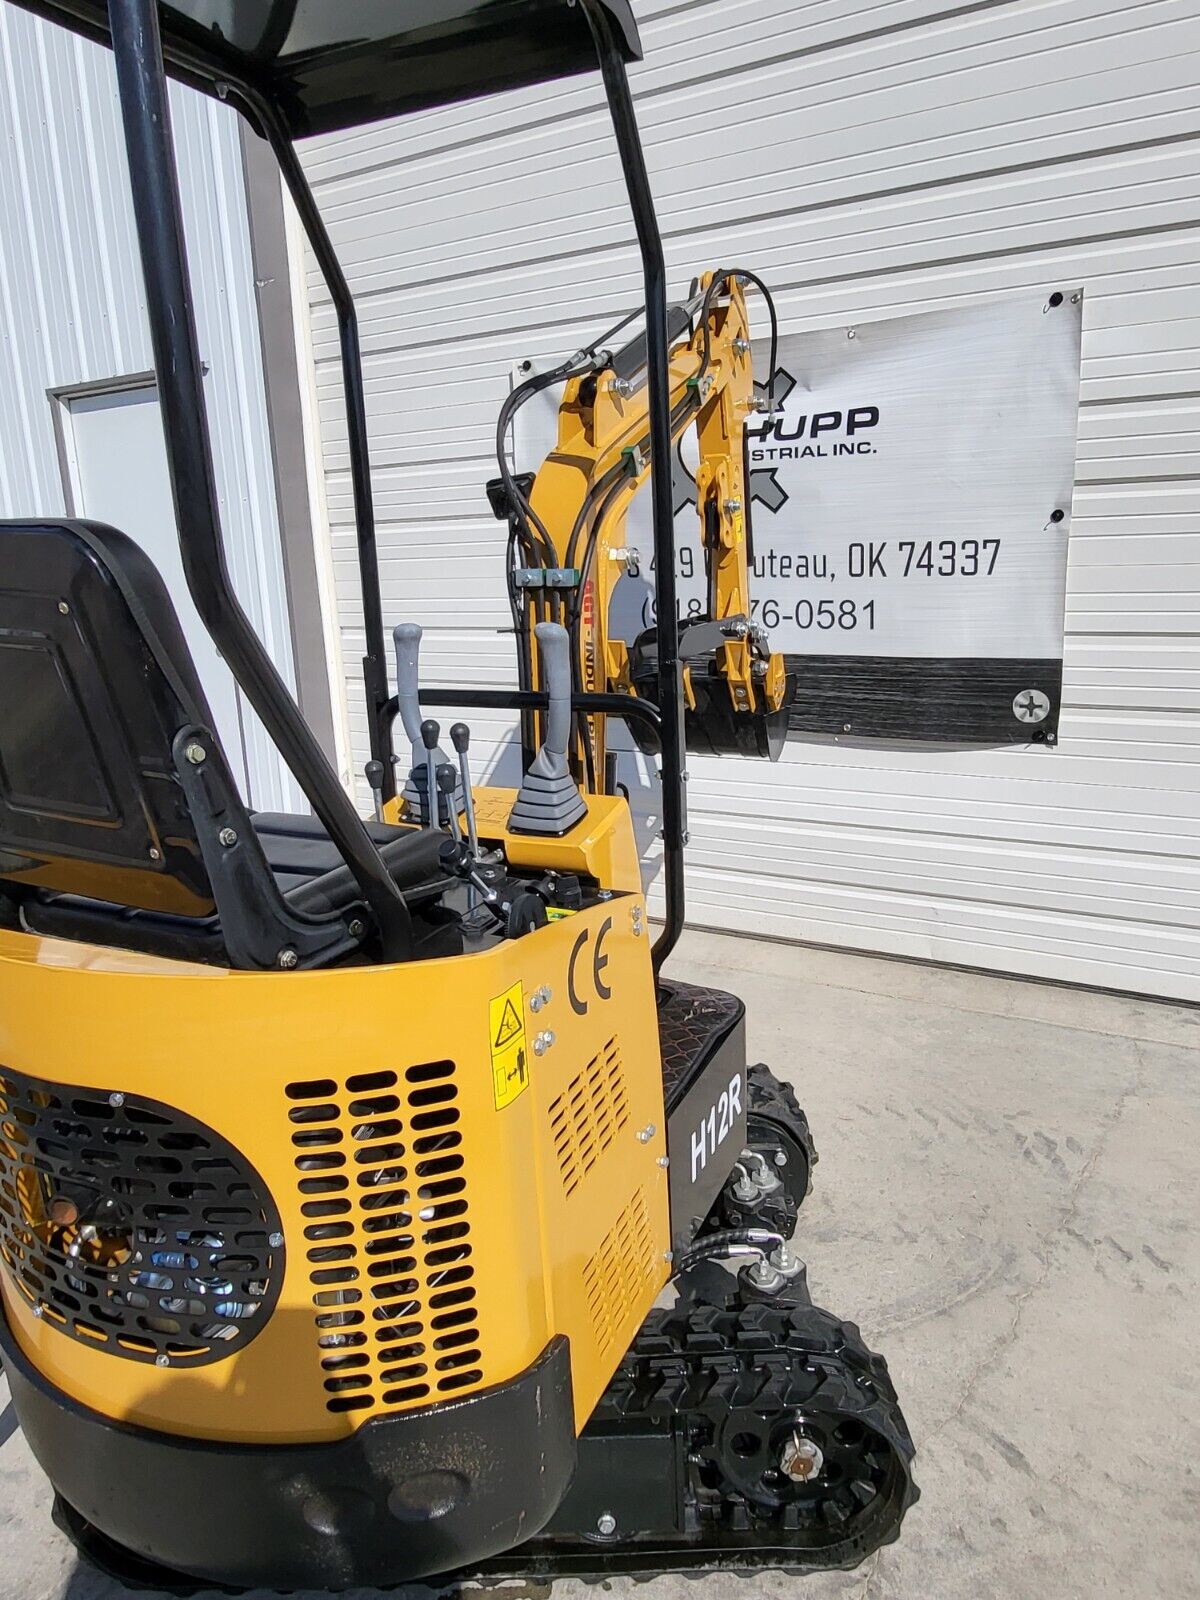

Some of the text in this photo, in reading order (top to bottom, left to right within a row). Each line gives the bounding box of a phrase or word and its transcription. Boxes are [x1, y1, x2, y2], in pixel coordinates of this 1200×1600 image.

[747, 406, 881, 443] HUPP
[751, 441, 877, 462] STRIAL INC.
[704, 547, 836, 582] uteau,
[848, 541, 888, 578] OK
[898, 538, 1002, 577] 74337
[750, 599, 876, 631] 76-0581
[567, 916, 612, 1016] CE
[690, 1072, 742, 1184] H12R
